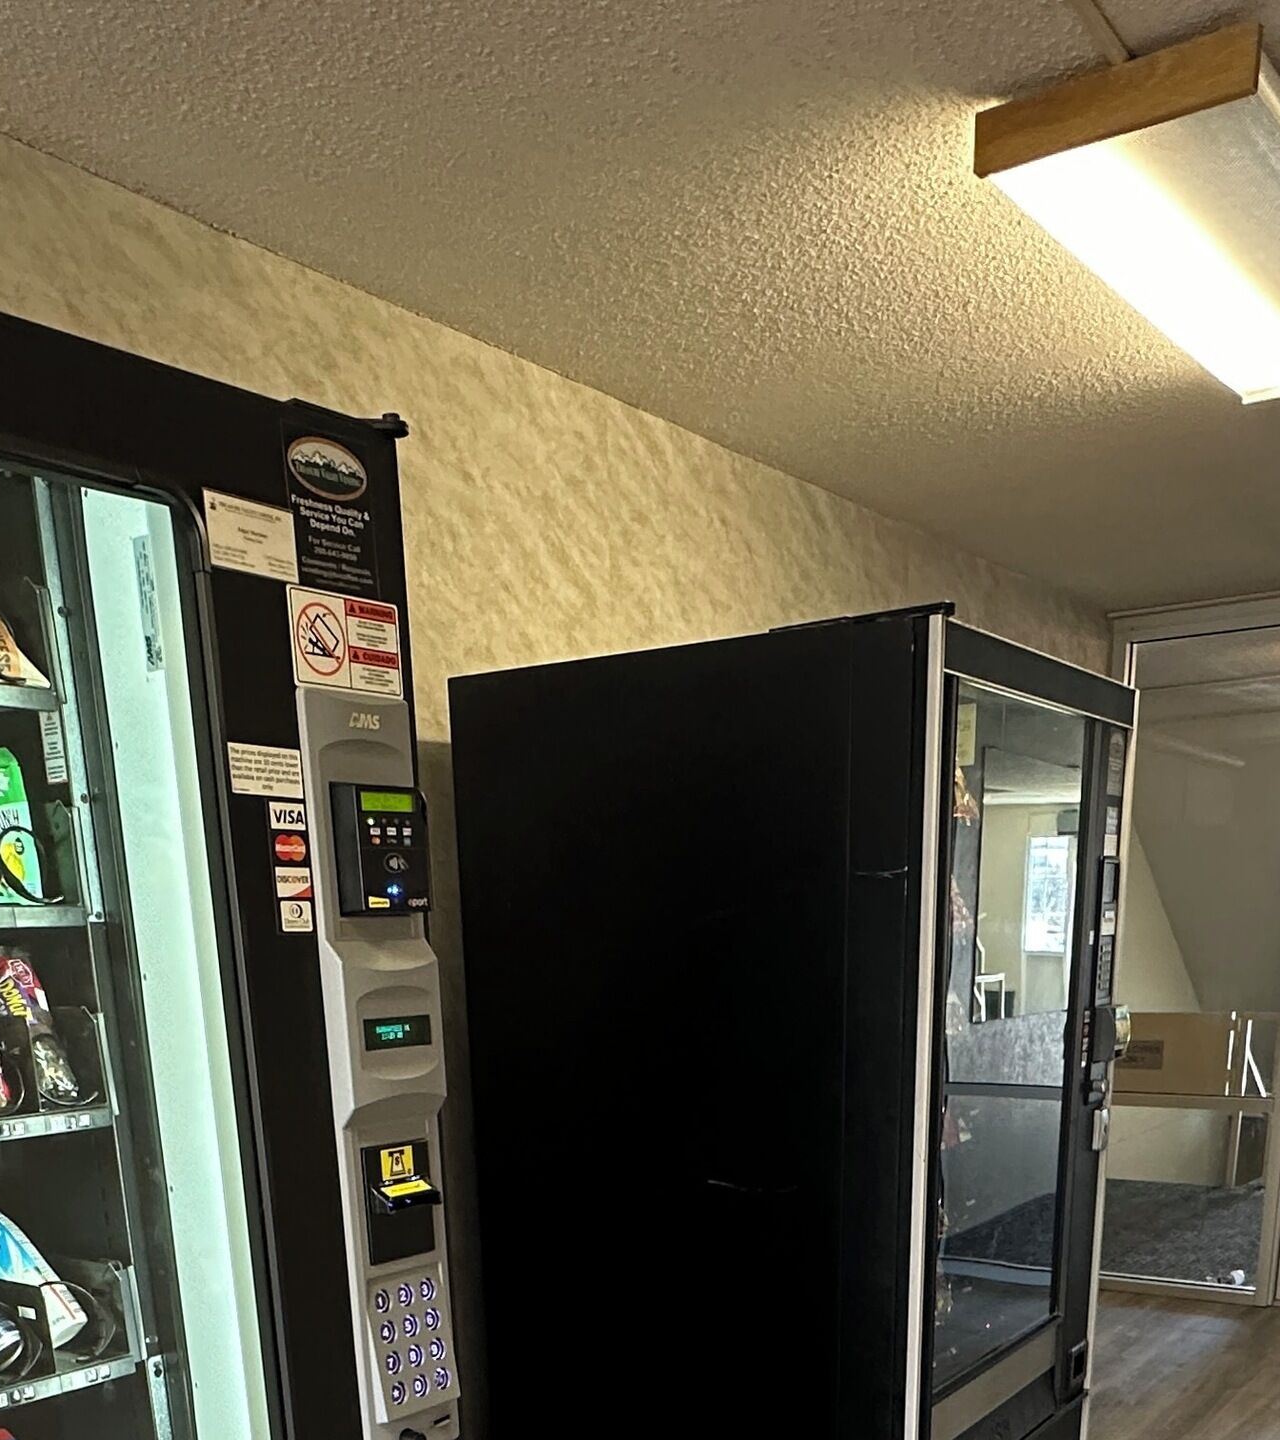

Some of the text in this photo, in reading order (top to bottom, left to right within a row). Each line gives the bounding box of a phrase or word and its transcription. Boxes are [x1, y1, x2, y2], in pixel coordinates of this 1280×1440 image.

[291, 493, 333, 514] Freshness
[335, 501, 363, 521] Quality
[363, 511, 371, 522] &
[300, 505, 365, 530] Service You Can
[310, 517, 340, 535] Depend
[348, 711, 380, 730] AMS
[273, 808, 305, 825] VISA
[276, 874, 309, 885] DISCOVER
